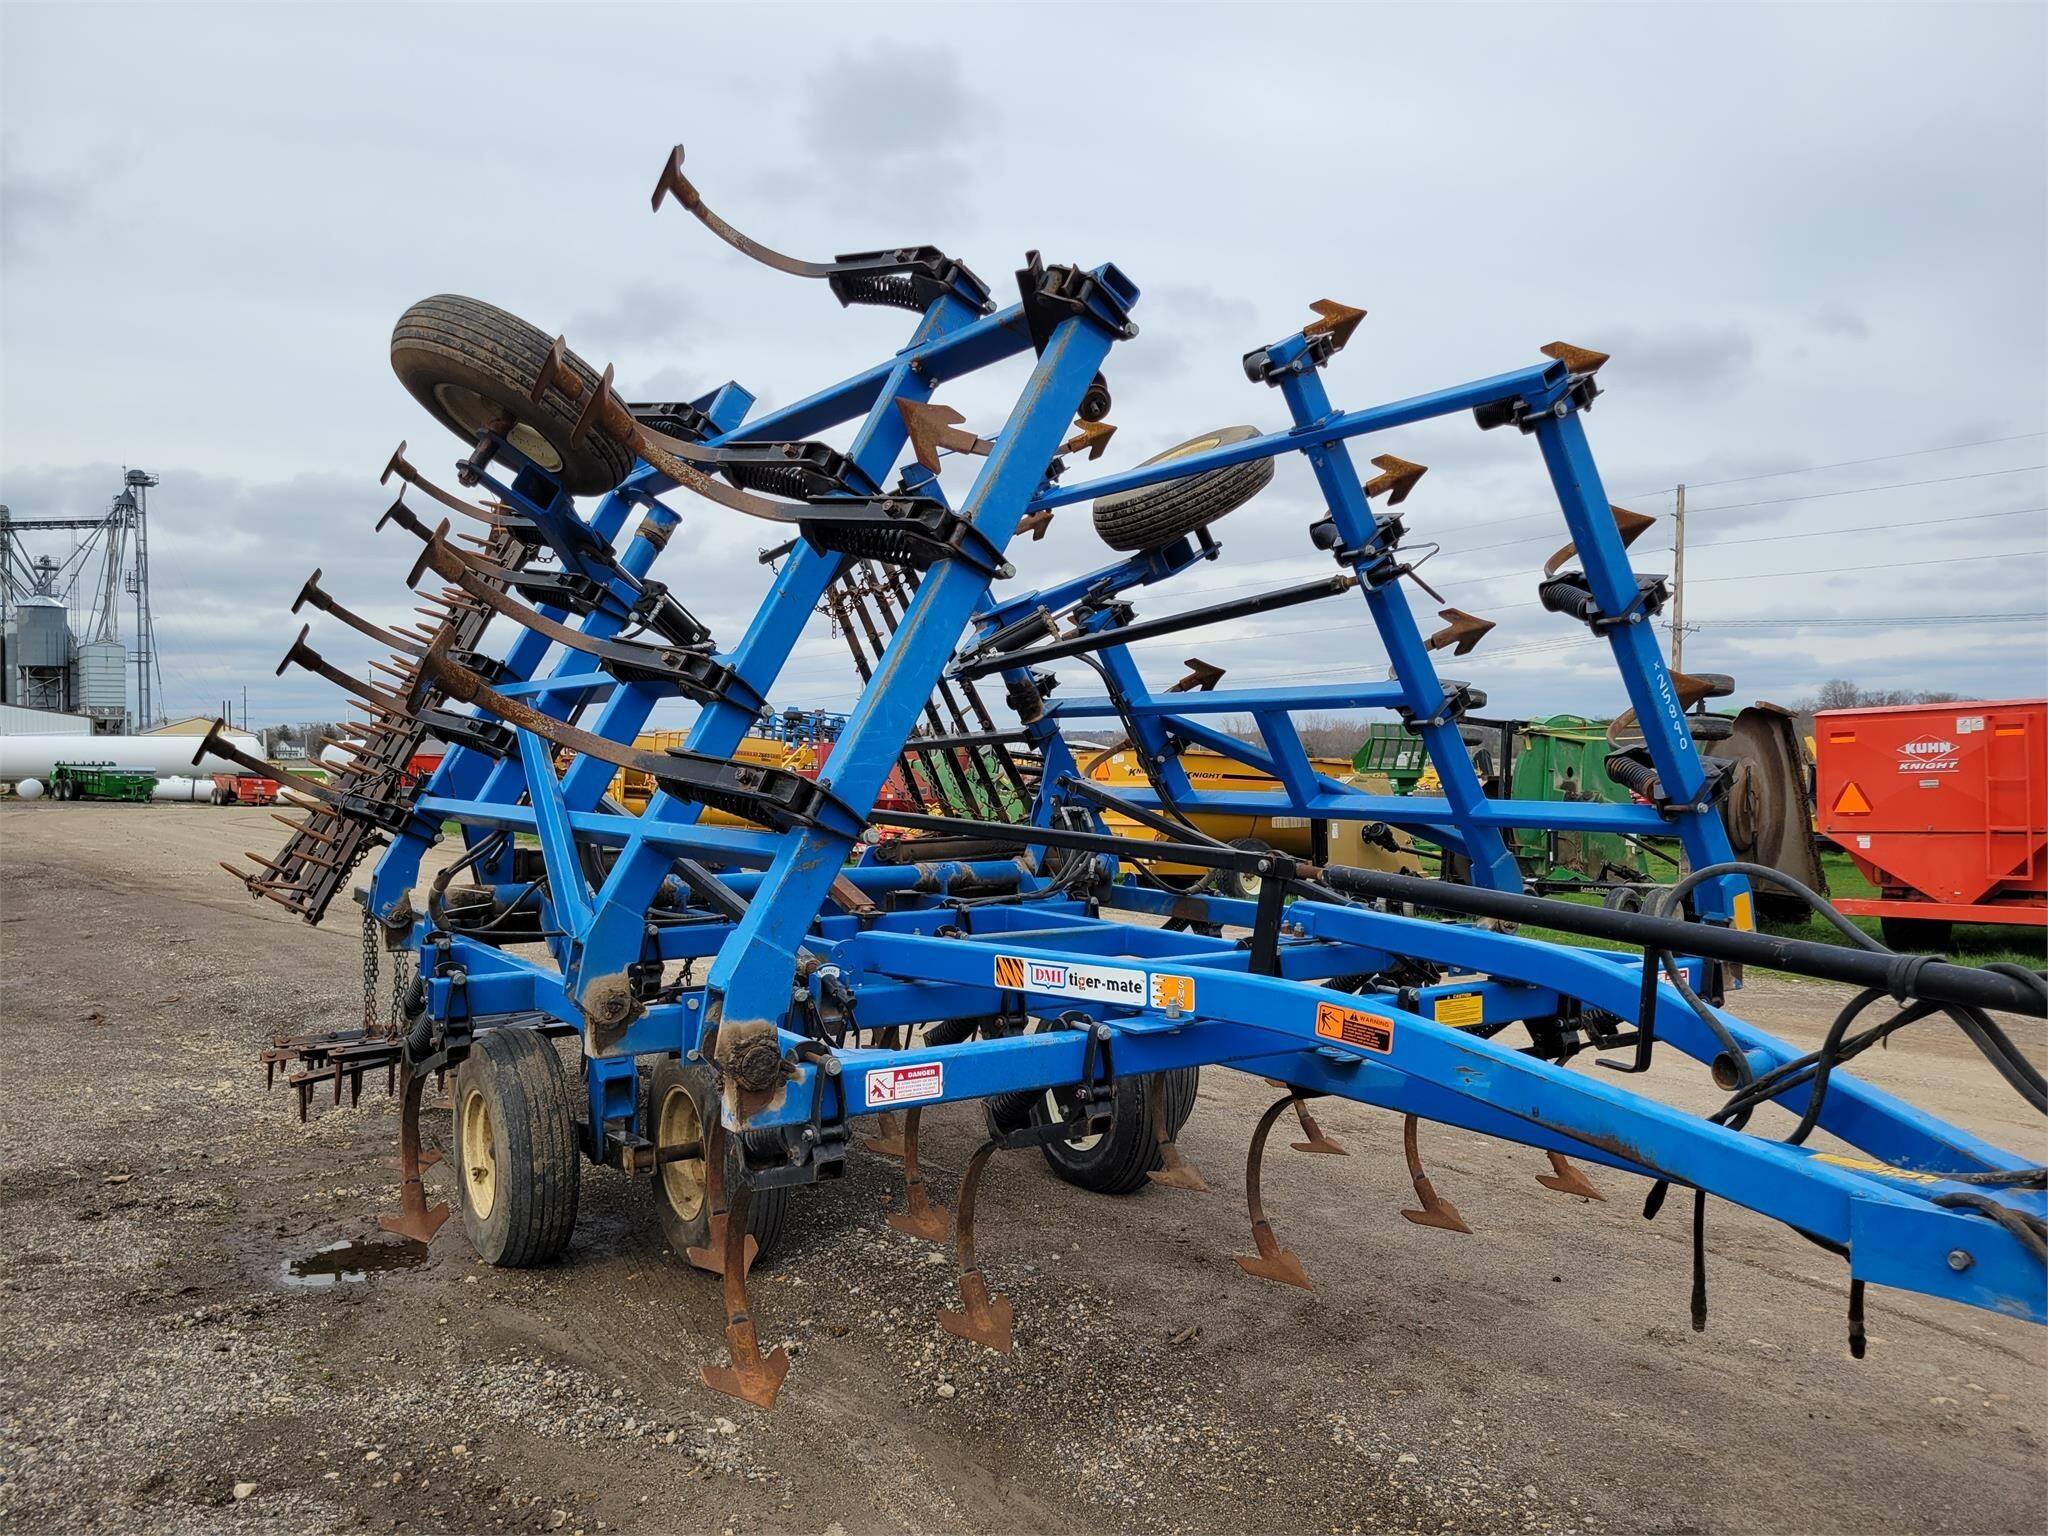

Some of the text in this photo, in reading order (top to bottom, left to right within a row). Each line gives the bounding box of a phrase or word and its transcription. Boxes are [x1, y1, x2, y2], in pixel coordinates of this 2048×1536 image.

[1905, 742, 1951, 753] KUHN
[1899, 761, 1958, 770] KNIGHT
[1035, 966, 1143, 994] DMI tiger-mate
[1359, 1015, 1390, 1028] WARNING
[907, 1069, 936, 1079] DANGER
